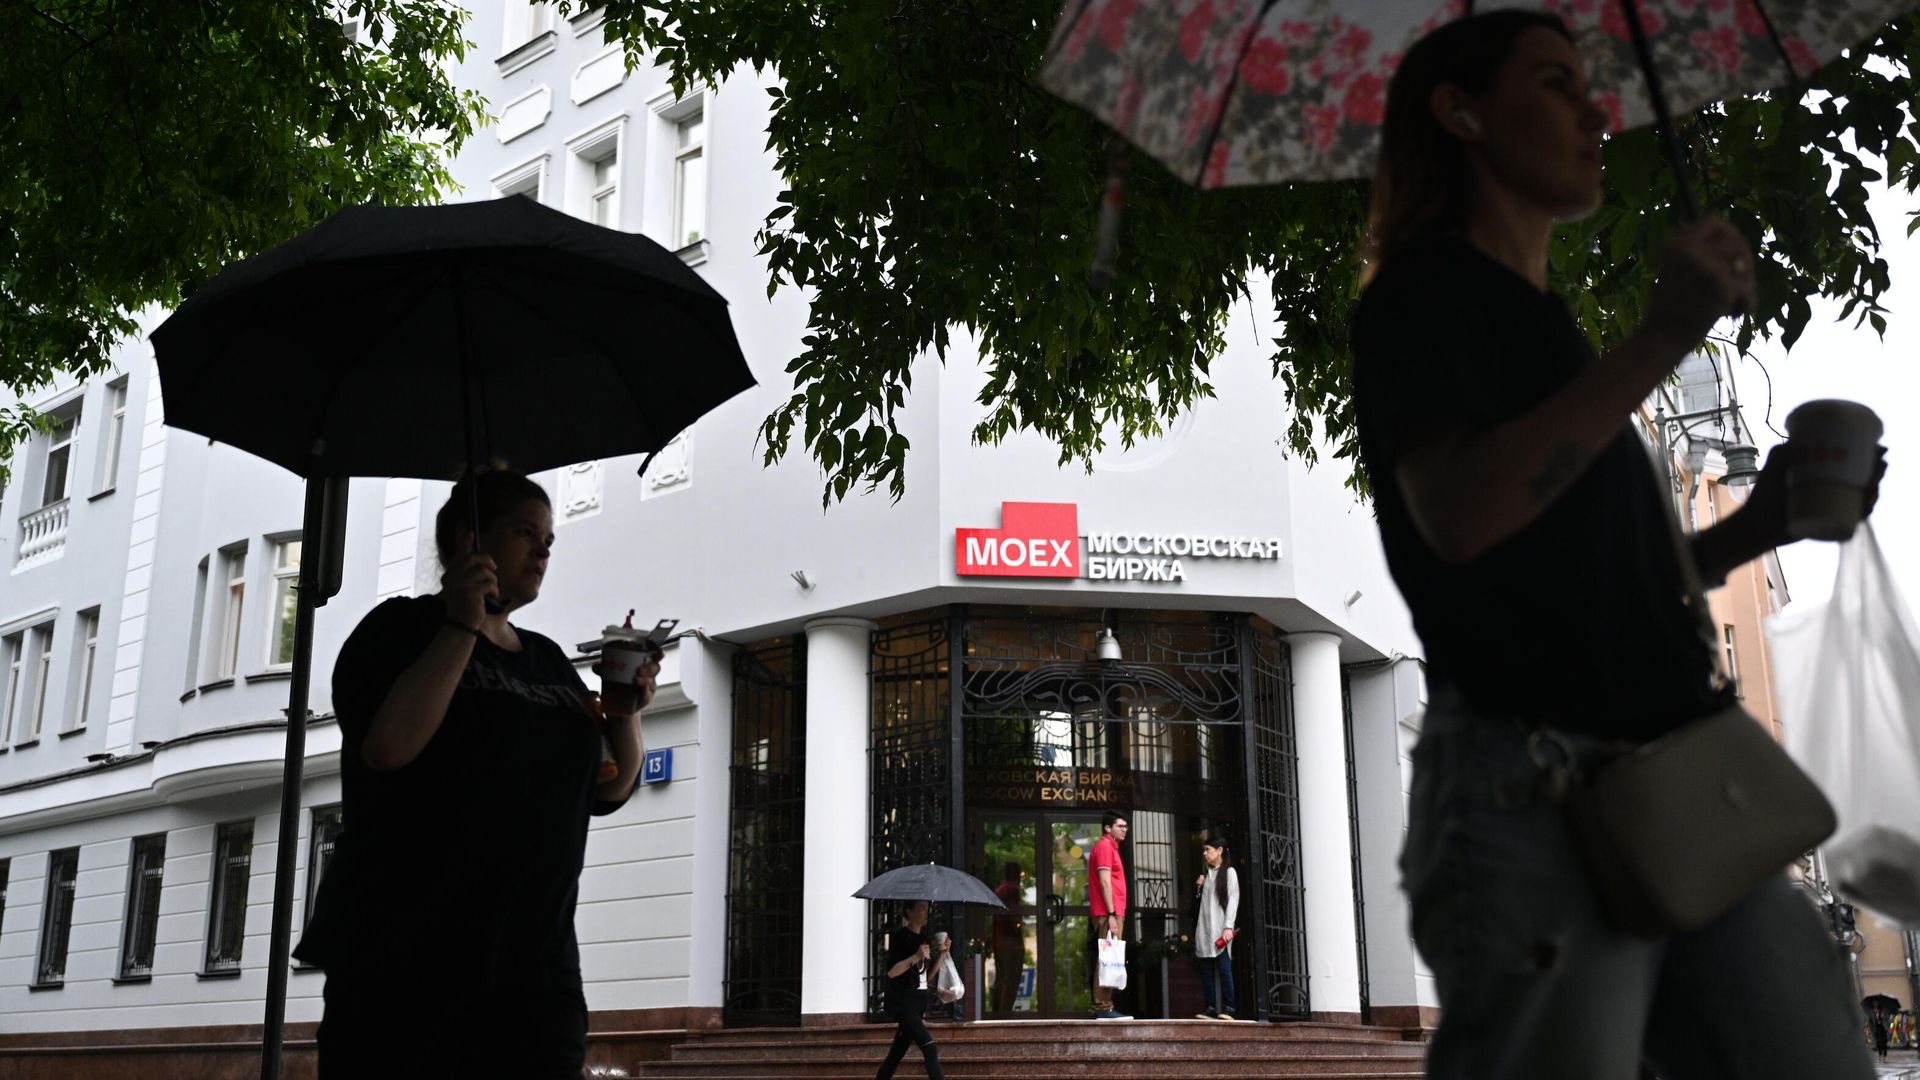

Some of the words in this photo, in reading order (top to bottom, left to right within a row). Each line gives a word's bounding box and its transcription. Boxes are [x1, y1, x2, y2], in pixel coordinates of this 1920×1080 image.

[966, 537, 1073, 568] MOEX
[1087, 531, 1283, 559] МОСКОВСКАЯ
[1088, 557, 1187, 582] БИРЖА
[648, 757, 662, 773] 13
[963, 770, 1072, 784] ОСКОВСКАЯ
